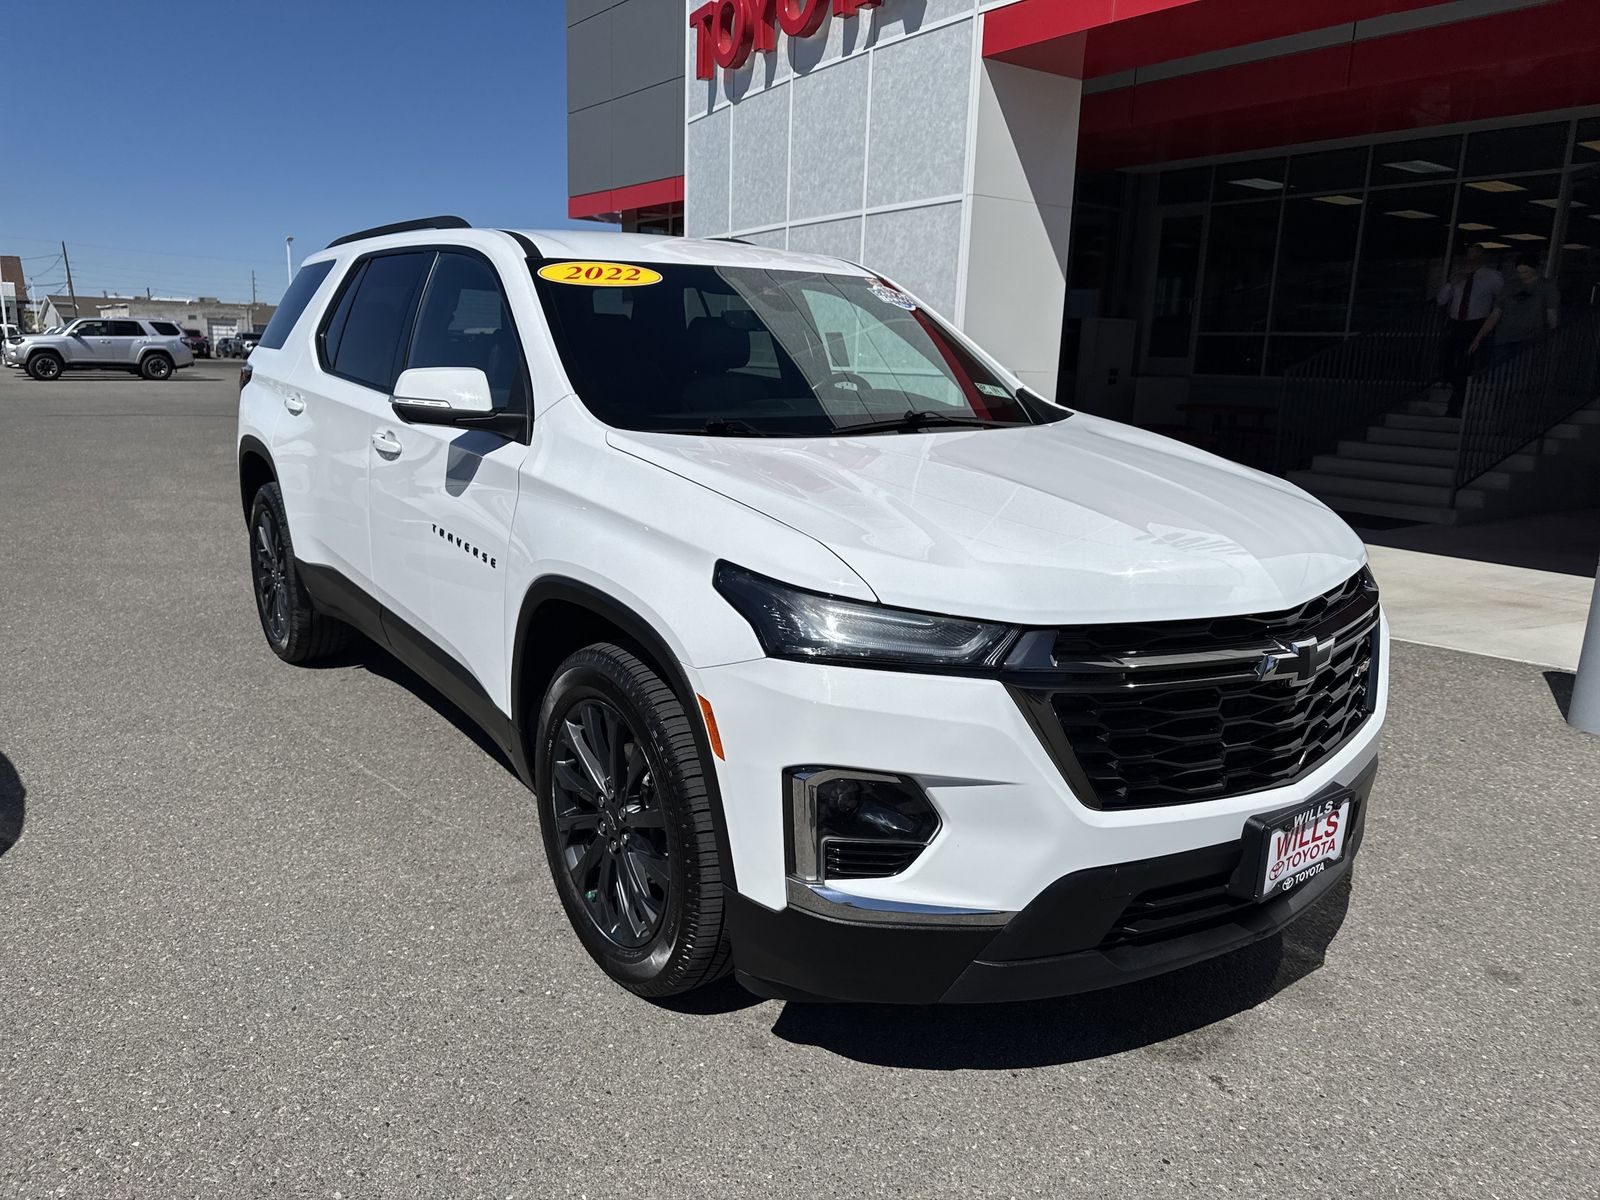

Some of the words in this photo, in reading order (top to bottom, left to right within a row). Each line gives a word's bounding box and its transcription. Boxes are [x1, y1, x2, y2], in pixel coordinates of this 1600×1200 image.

[690, 0, 884, 80] TOYO
[564, 266, 641, 281] 2022
[432, 523, 496, 569] TRAVERSE
[1294, 800, 1334, 828] WILLS
[1277, 811, 1340, 861] WILLS
[1286, 838, 1335, 871] TOYOTA
[1295, 862, 1325, 884] TOYOTA
